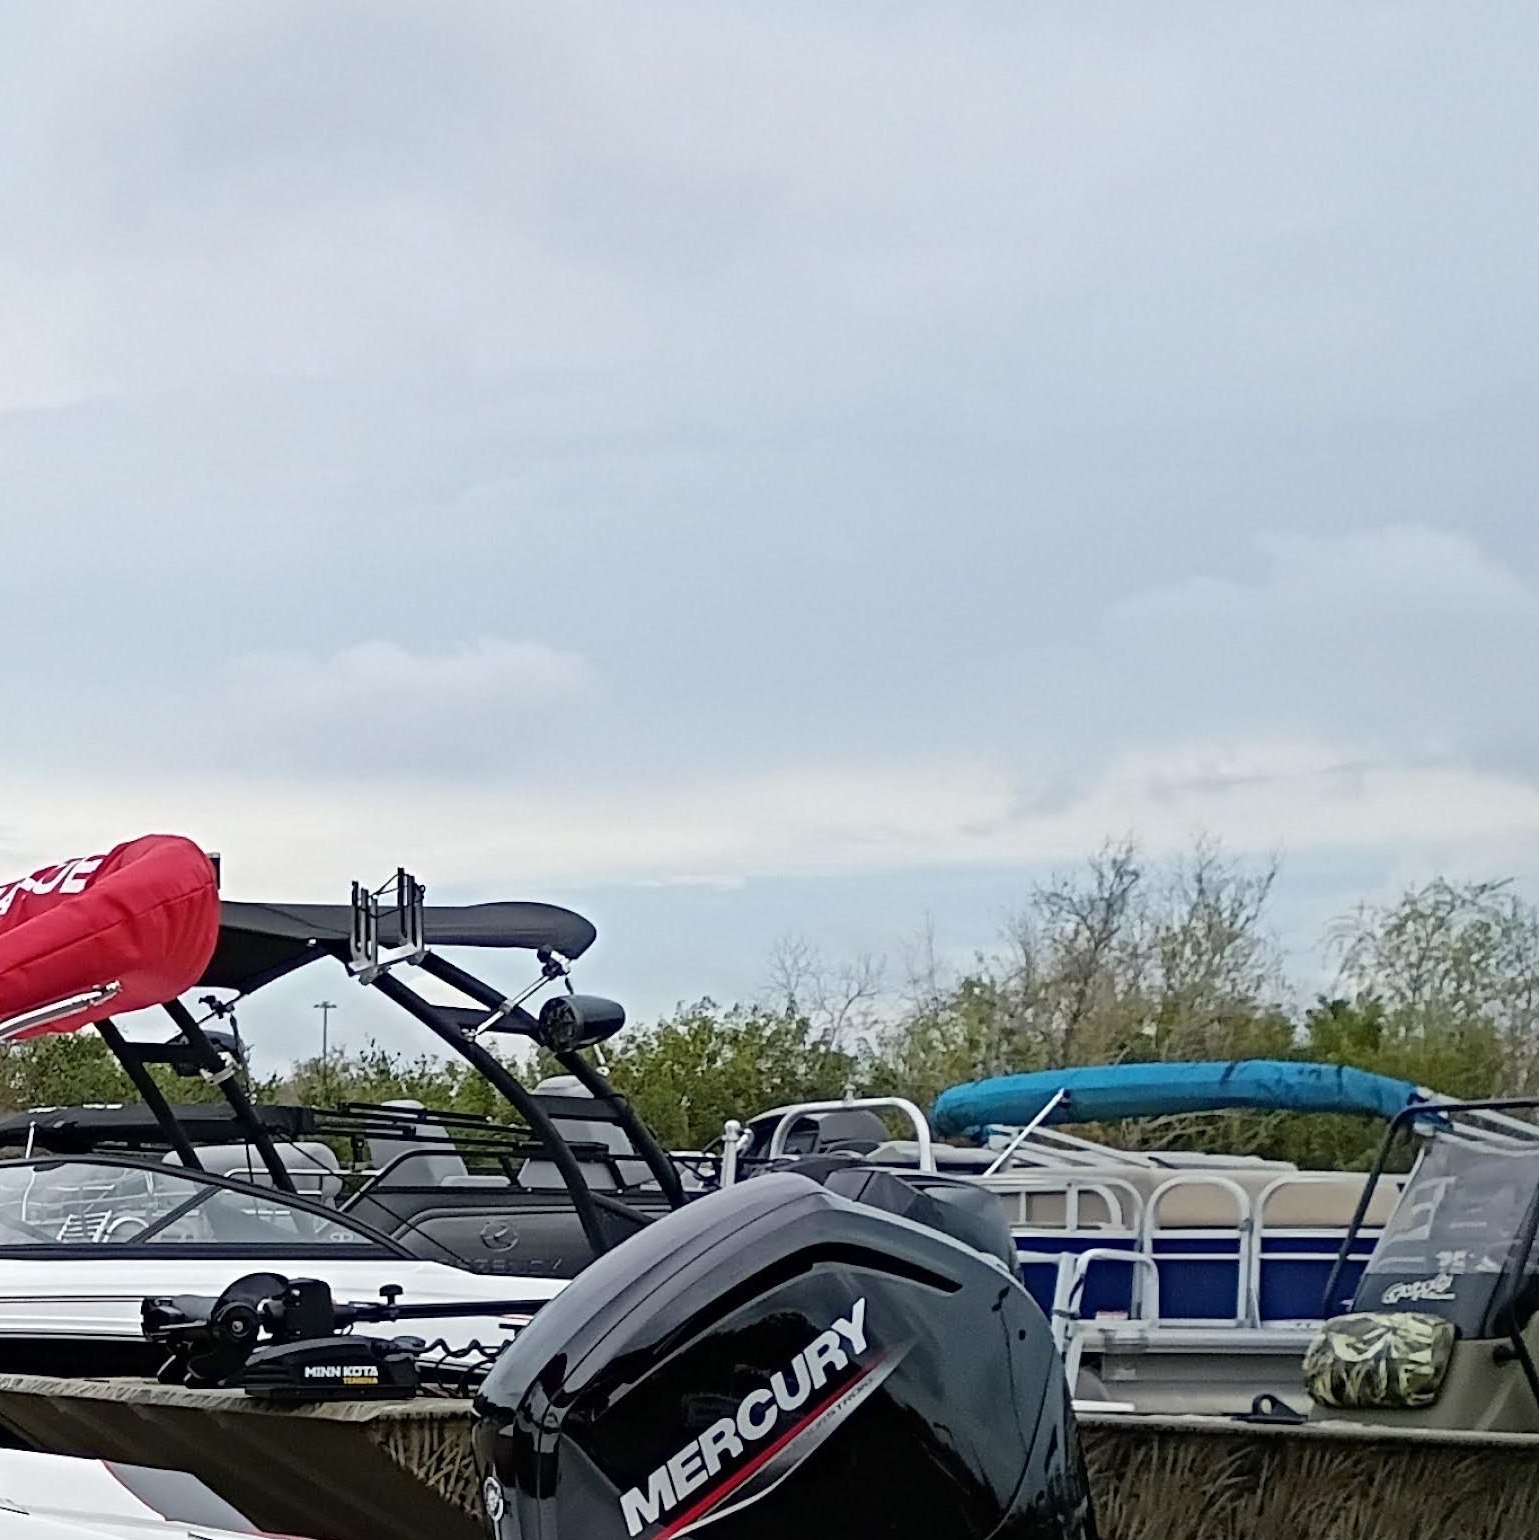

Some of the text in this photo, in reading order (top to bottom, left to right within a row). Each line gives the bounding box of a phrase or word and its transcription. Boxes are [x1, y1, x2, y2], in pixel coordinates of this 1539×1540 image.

[304, 1365, 379, 1378] MINN KOTA
[620, 1297, 868, 1537] MERCURY
